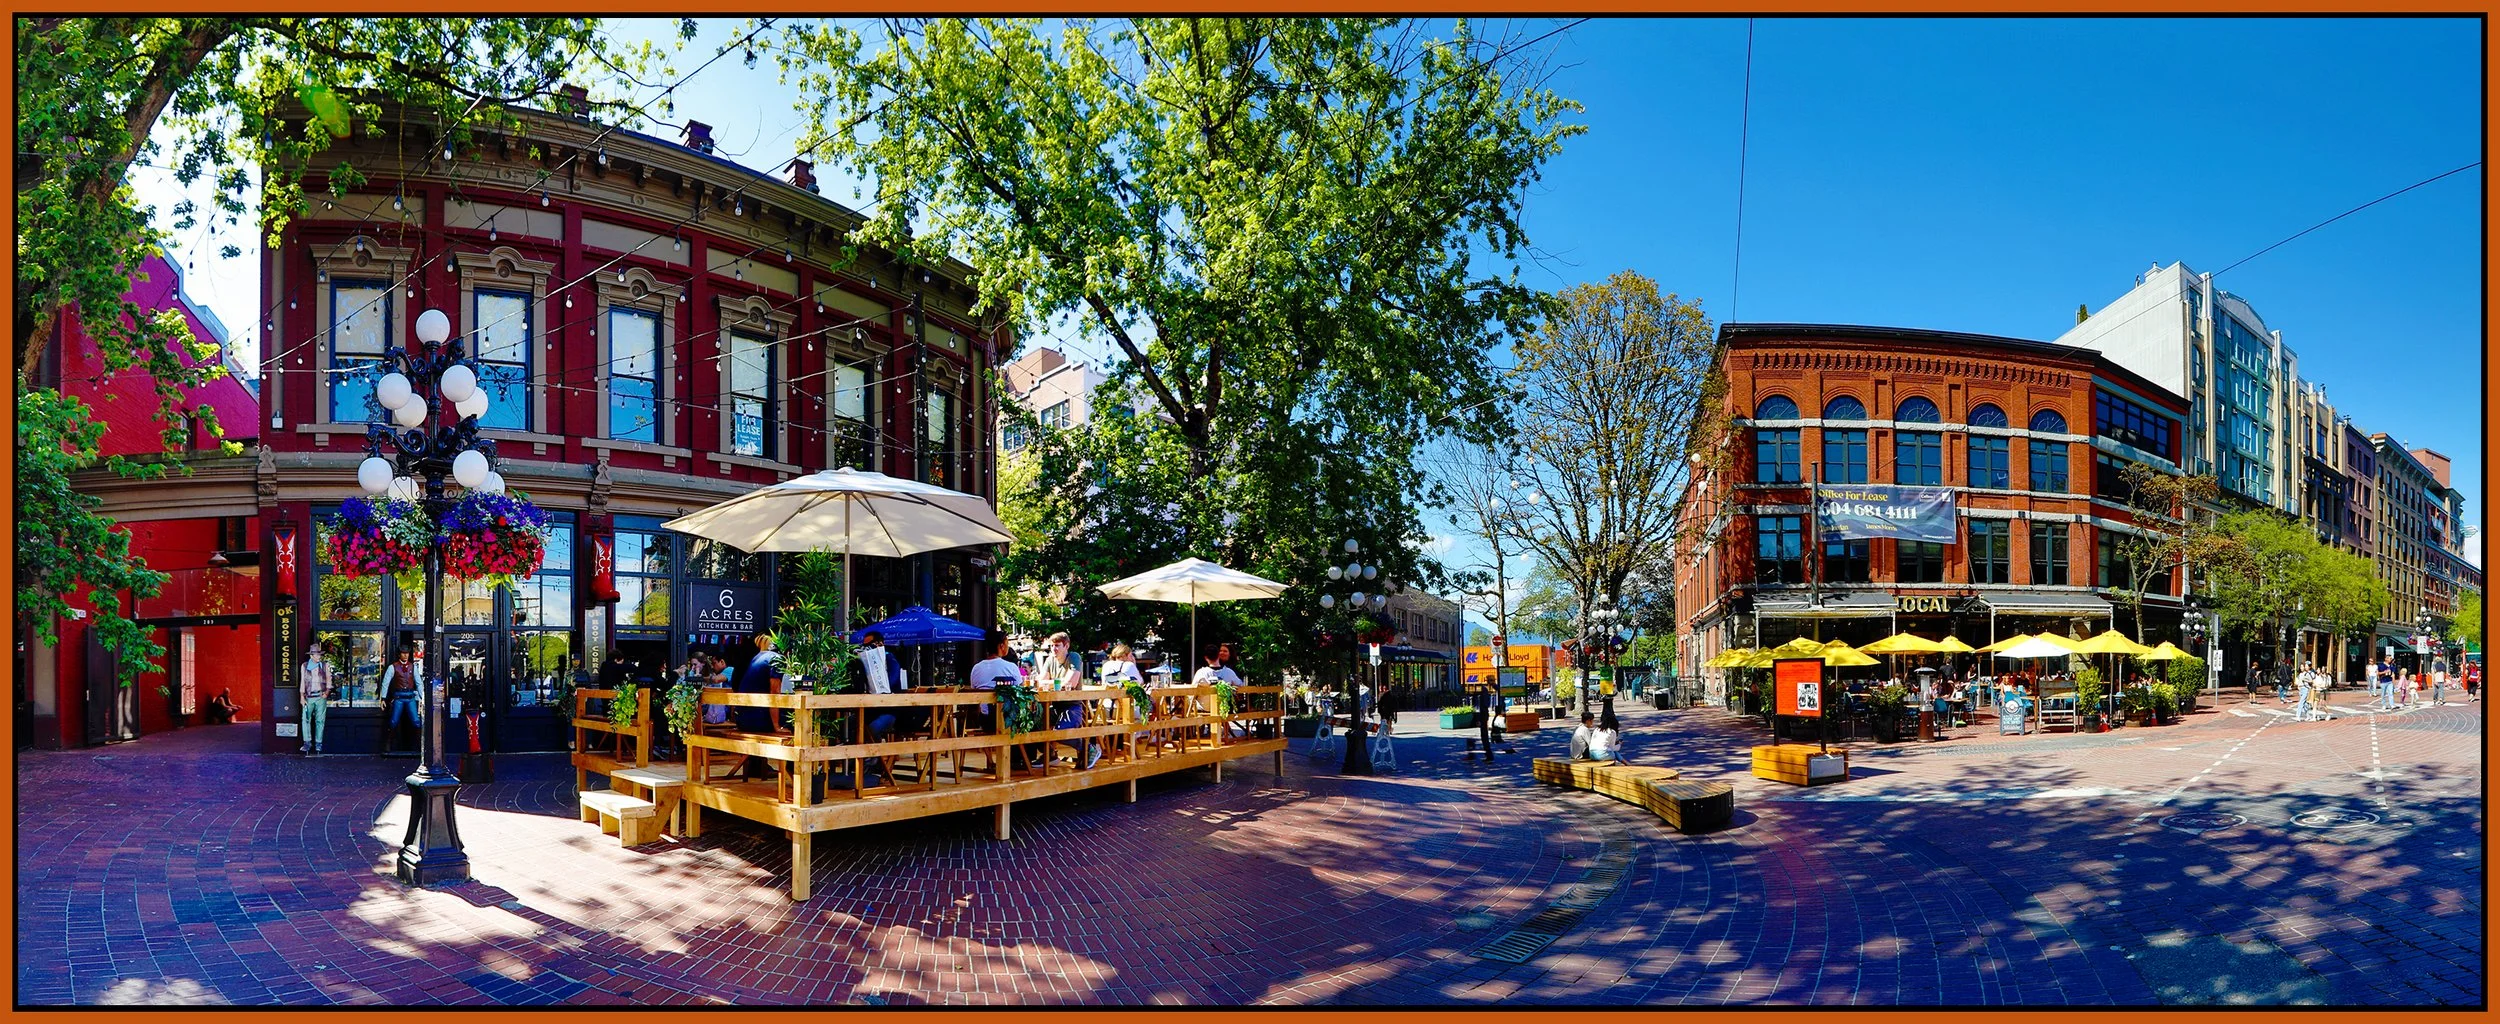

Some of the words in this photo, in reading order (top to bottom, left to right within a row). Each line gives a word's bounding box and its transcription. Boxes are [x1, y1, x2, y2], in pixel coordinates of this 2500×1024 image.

[738, 424, 760, 435] LEASE
[1818, 489, 1843, 499] Office
[1845, 491, 1861, 500] For
[1862, 491, 1888, 501] Lease
[1820, 501, 1851, 516] 604
[1854, 504, 1881, 517] 681
[1885, 506, 1917, 519] 4111
[719, 589, 734, 608] 6
[1894, 596, 1950, 612] LOCAL
[277, 605, 294, 616] OK
[588, 608, 602, 617] OK
[699, 609, 753, 620] ACRES
[281, 617, 290, 641] BOOT
[591, 619, 599, 641] BOOT
[699, 622, 730, 630] KITCHEN
[281, 645, 290, 682] CORRAL
[591, 646, 599, 674] CORRA
[1482, 653, 1530, 662] Ha-Lloyd
